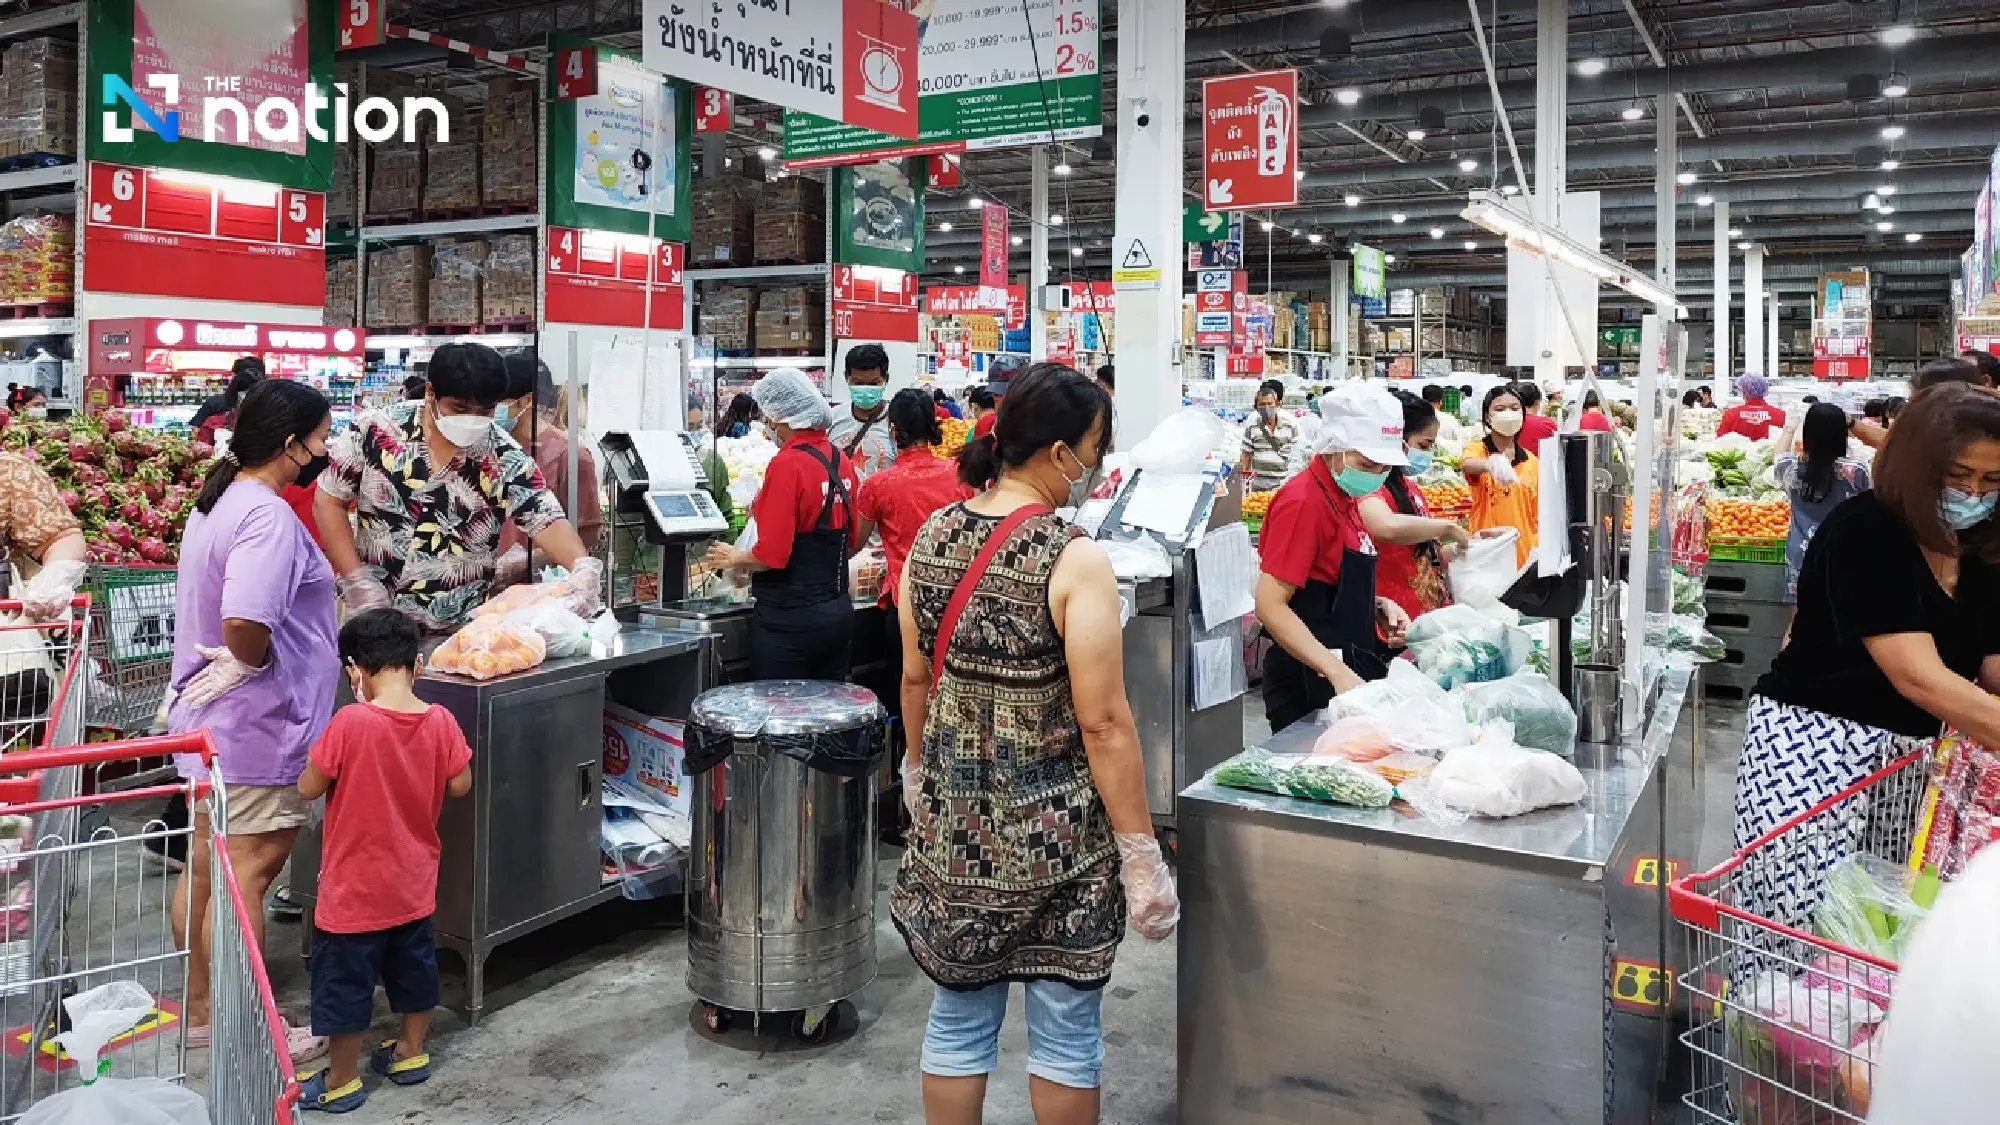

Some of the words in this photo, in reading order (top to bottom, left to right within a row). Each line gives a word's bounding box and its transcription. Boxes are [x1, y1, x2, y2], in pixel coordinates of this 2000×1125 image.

[350, 0, 369, 26] 5
[1055, 11, 1097, 36] 1.5%
[566, 50, 584, 79] 4
[1056, 43, 1096, 75] 2%
[704, 89, 721, 116] 3
[112, 169, 135, 201] 6
[288, 193, 307, 222] 5
[560, 231, 573, 255] 4
[662, 245, 673, 267] 3
[841, 268, 850, 286] 2
[905, 275, 911, 292] 1
